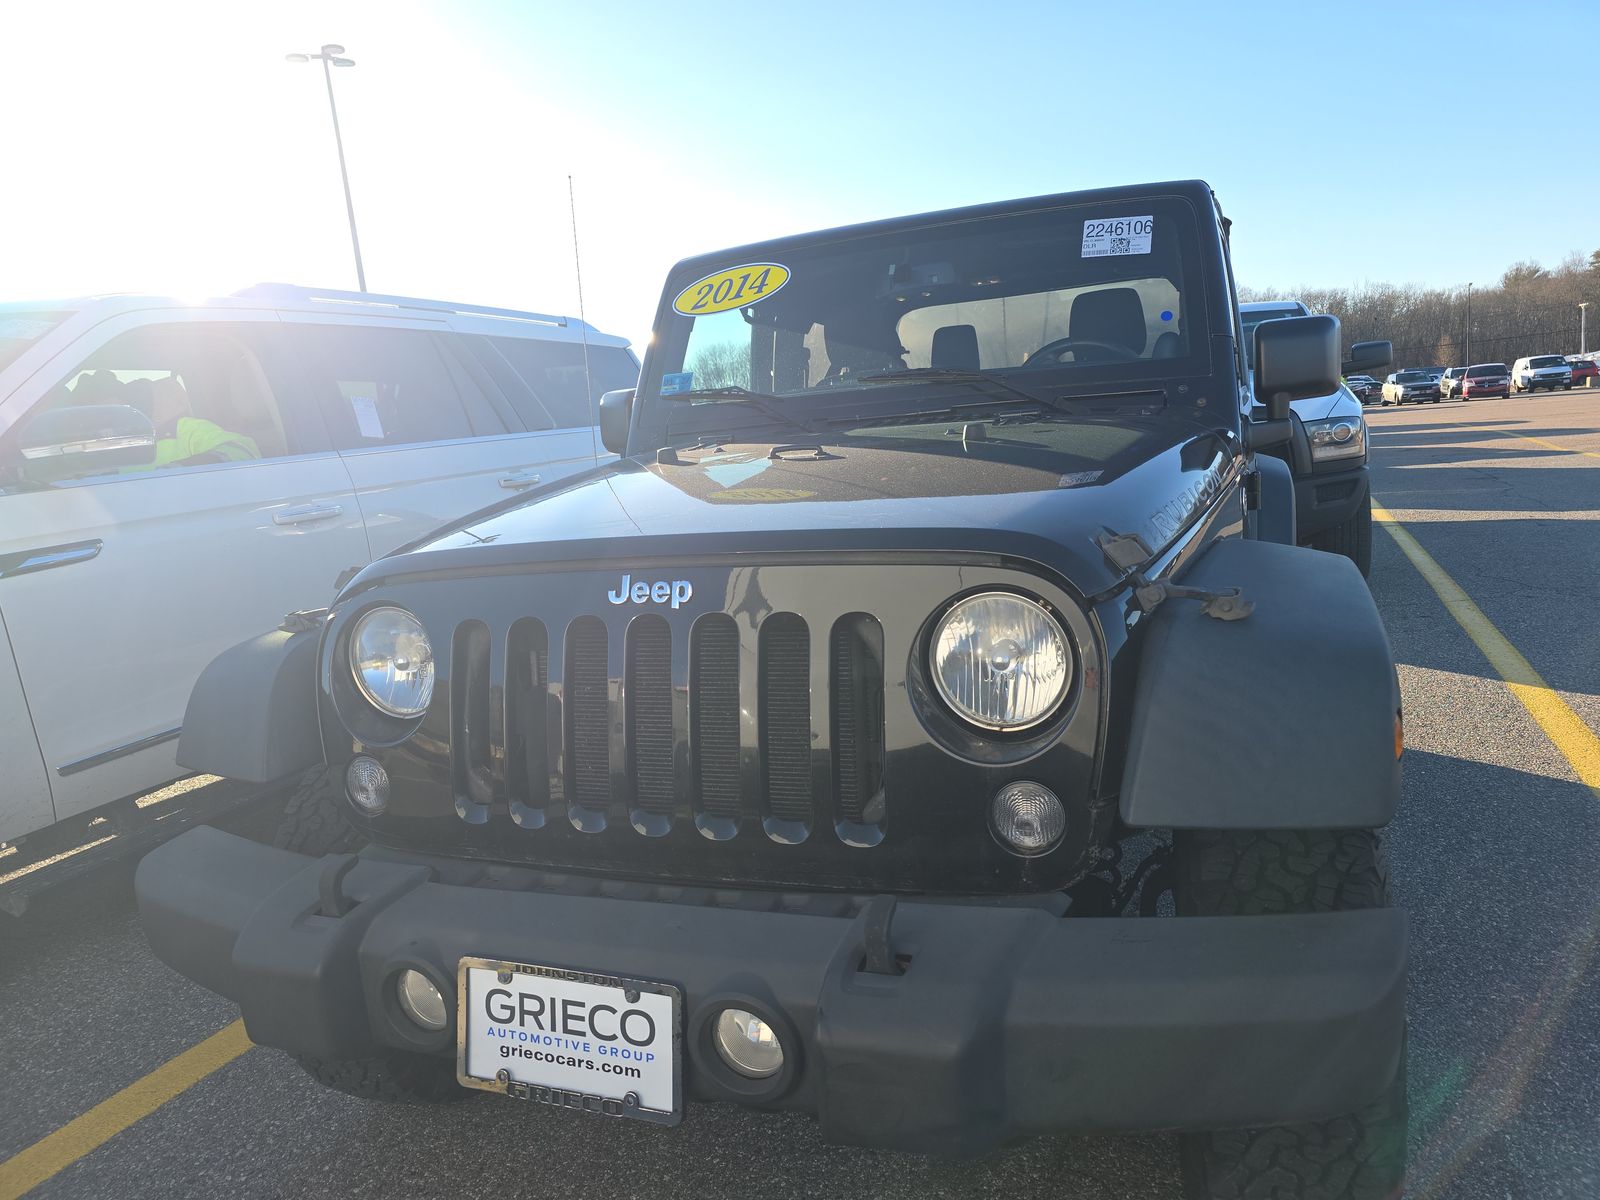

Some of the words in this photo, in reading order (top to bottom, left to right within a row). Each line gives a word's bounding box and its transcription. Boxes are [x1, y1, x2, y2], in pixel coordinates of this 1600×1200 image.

[1085, 219, 1153, 238] 2246106
[690, 267, 772, 311] 2014
[1151, 465, 1223, 542] RUBICON
[607, 574, 693, 610] Jeep
[485, 988, 656, 1047] GRIECO
[487, 1026, 591, 1053] AUTOMOTIVE
[598, 1045, 655, 1063] GROUP
[499, 1044, 641, 1079] griecocars.com
